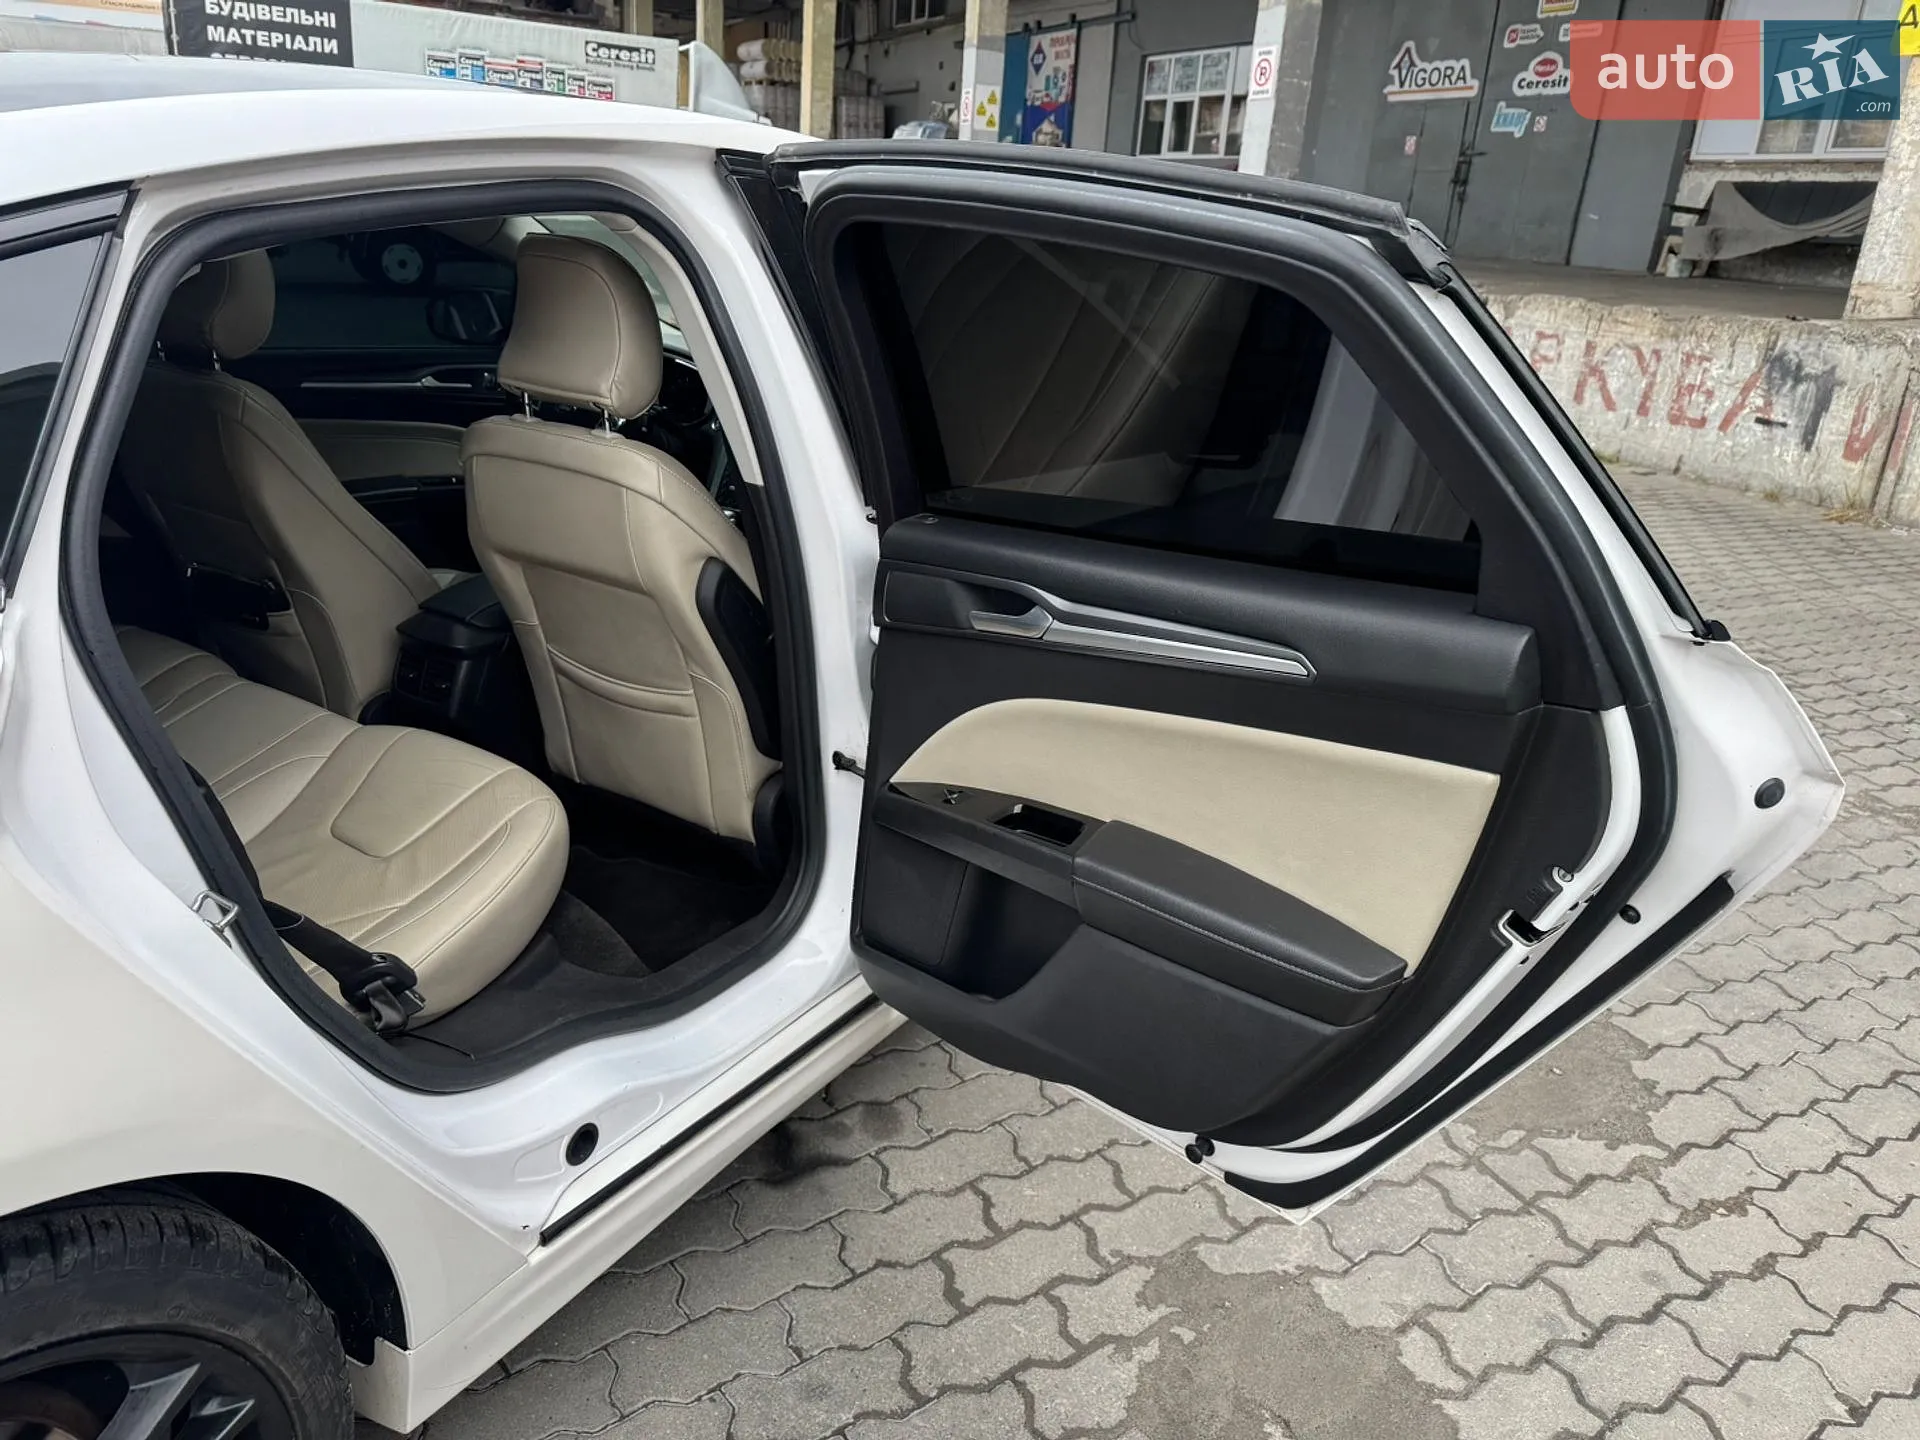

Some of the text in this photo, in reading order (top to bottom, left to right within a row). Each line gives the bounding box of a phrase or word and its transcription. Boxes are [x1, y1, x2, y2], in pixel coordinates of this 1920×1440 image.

[204, 0, 336, 29] БУДІВЕЛЬНІ
[206, 24, 339, 55] МАТЕРІАЛИ
[585, 42, 655, 64] Ceresit
[1394, 50, 1467, 88] VIGORA
[1517, 74, 1569, 90] Ceresit
